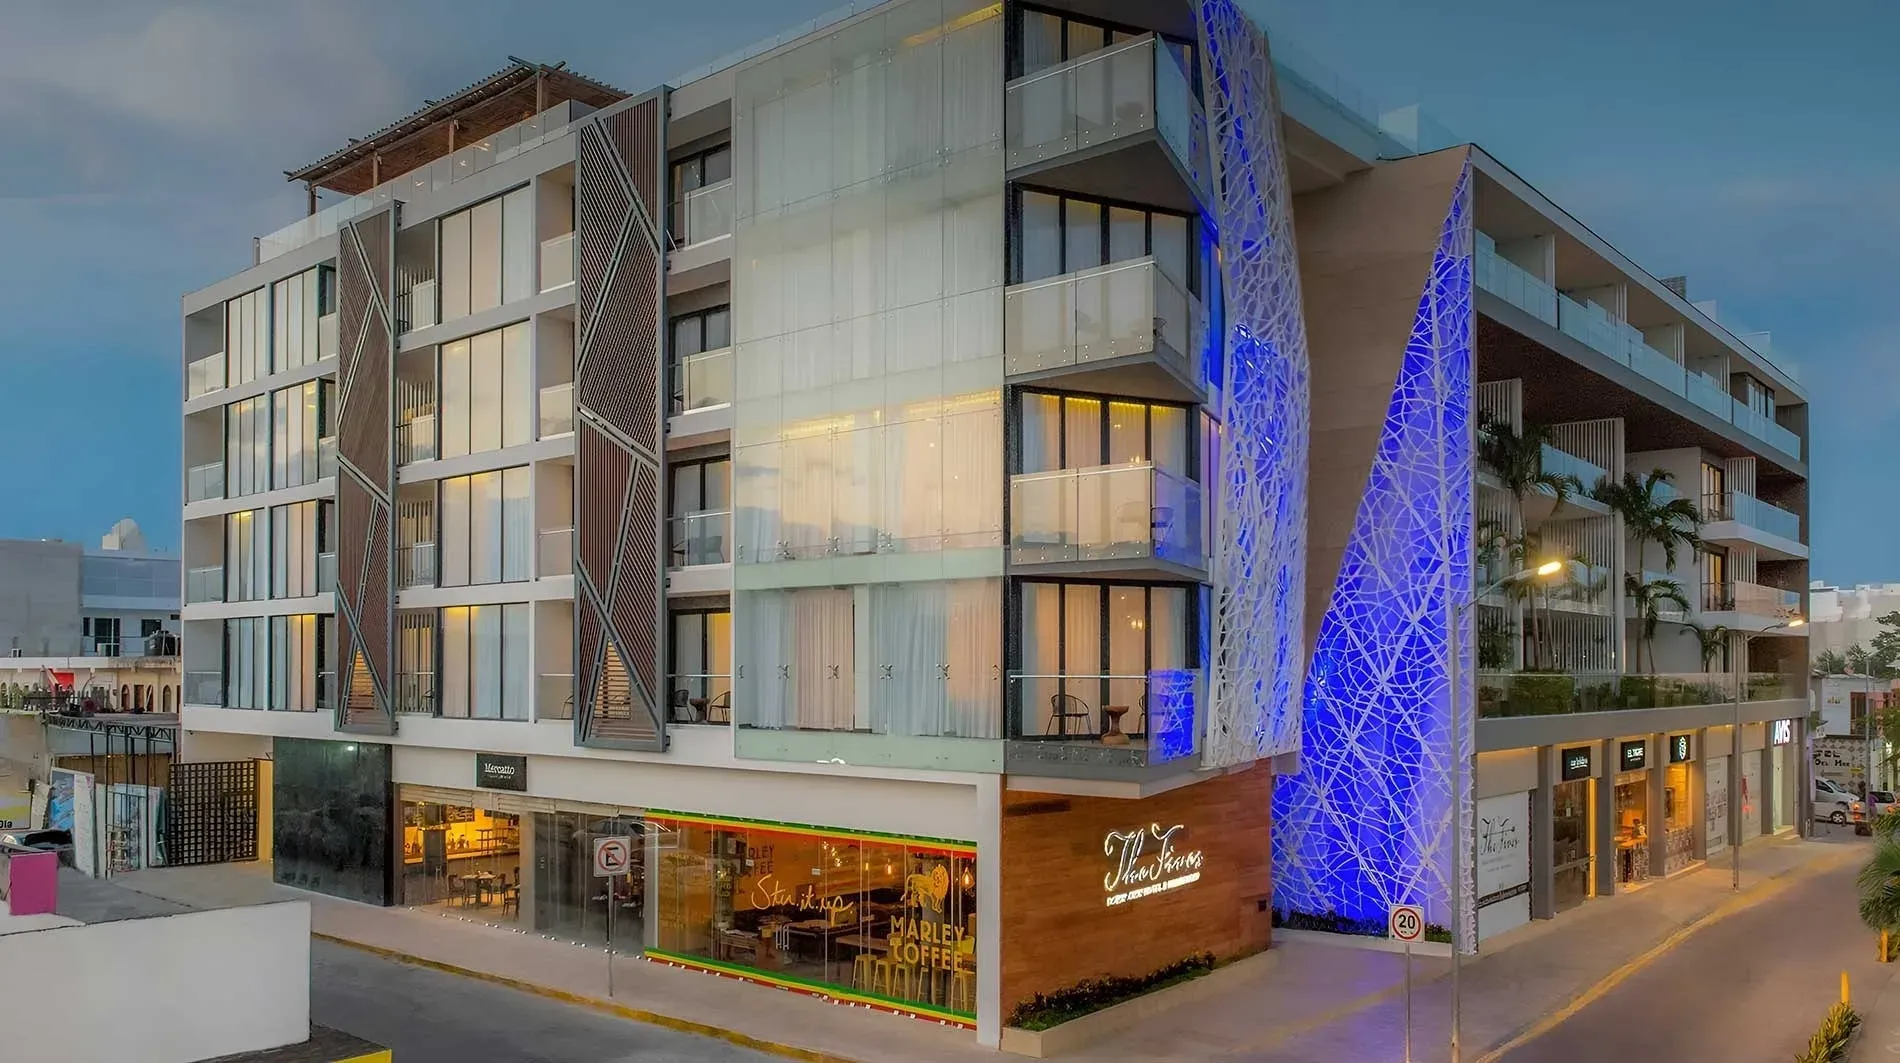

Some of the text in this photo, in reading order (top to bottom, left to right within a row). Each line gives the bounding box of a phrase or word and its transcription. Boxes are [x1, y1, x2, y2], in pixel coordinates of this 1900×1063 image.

[1774, 719, 1791, 745] AVIS
[890, 914, 965, 946] MARLEY
[1398, 914, 1416, 929] 20
[893, 941, 963, 974] COFFEE
